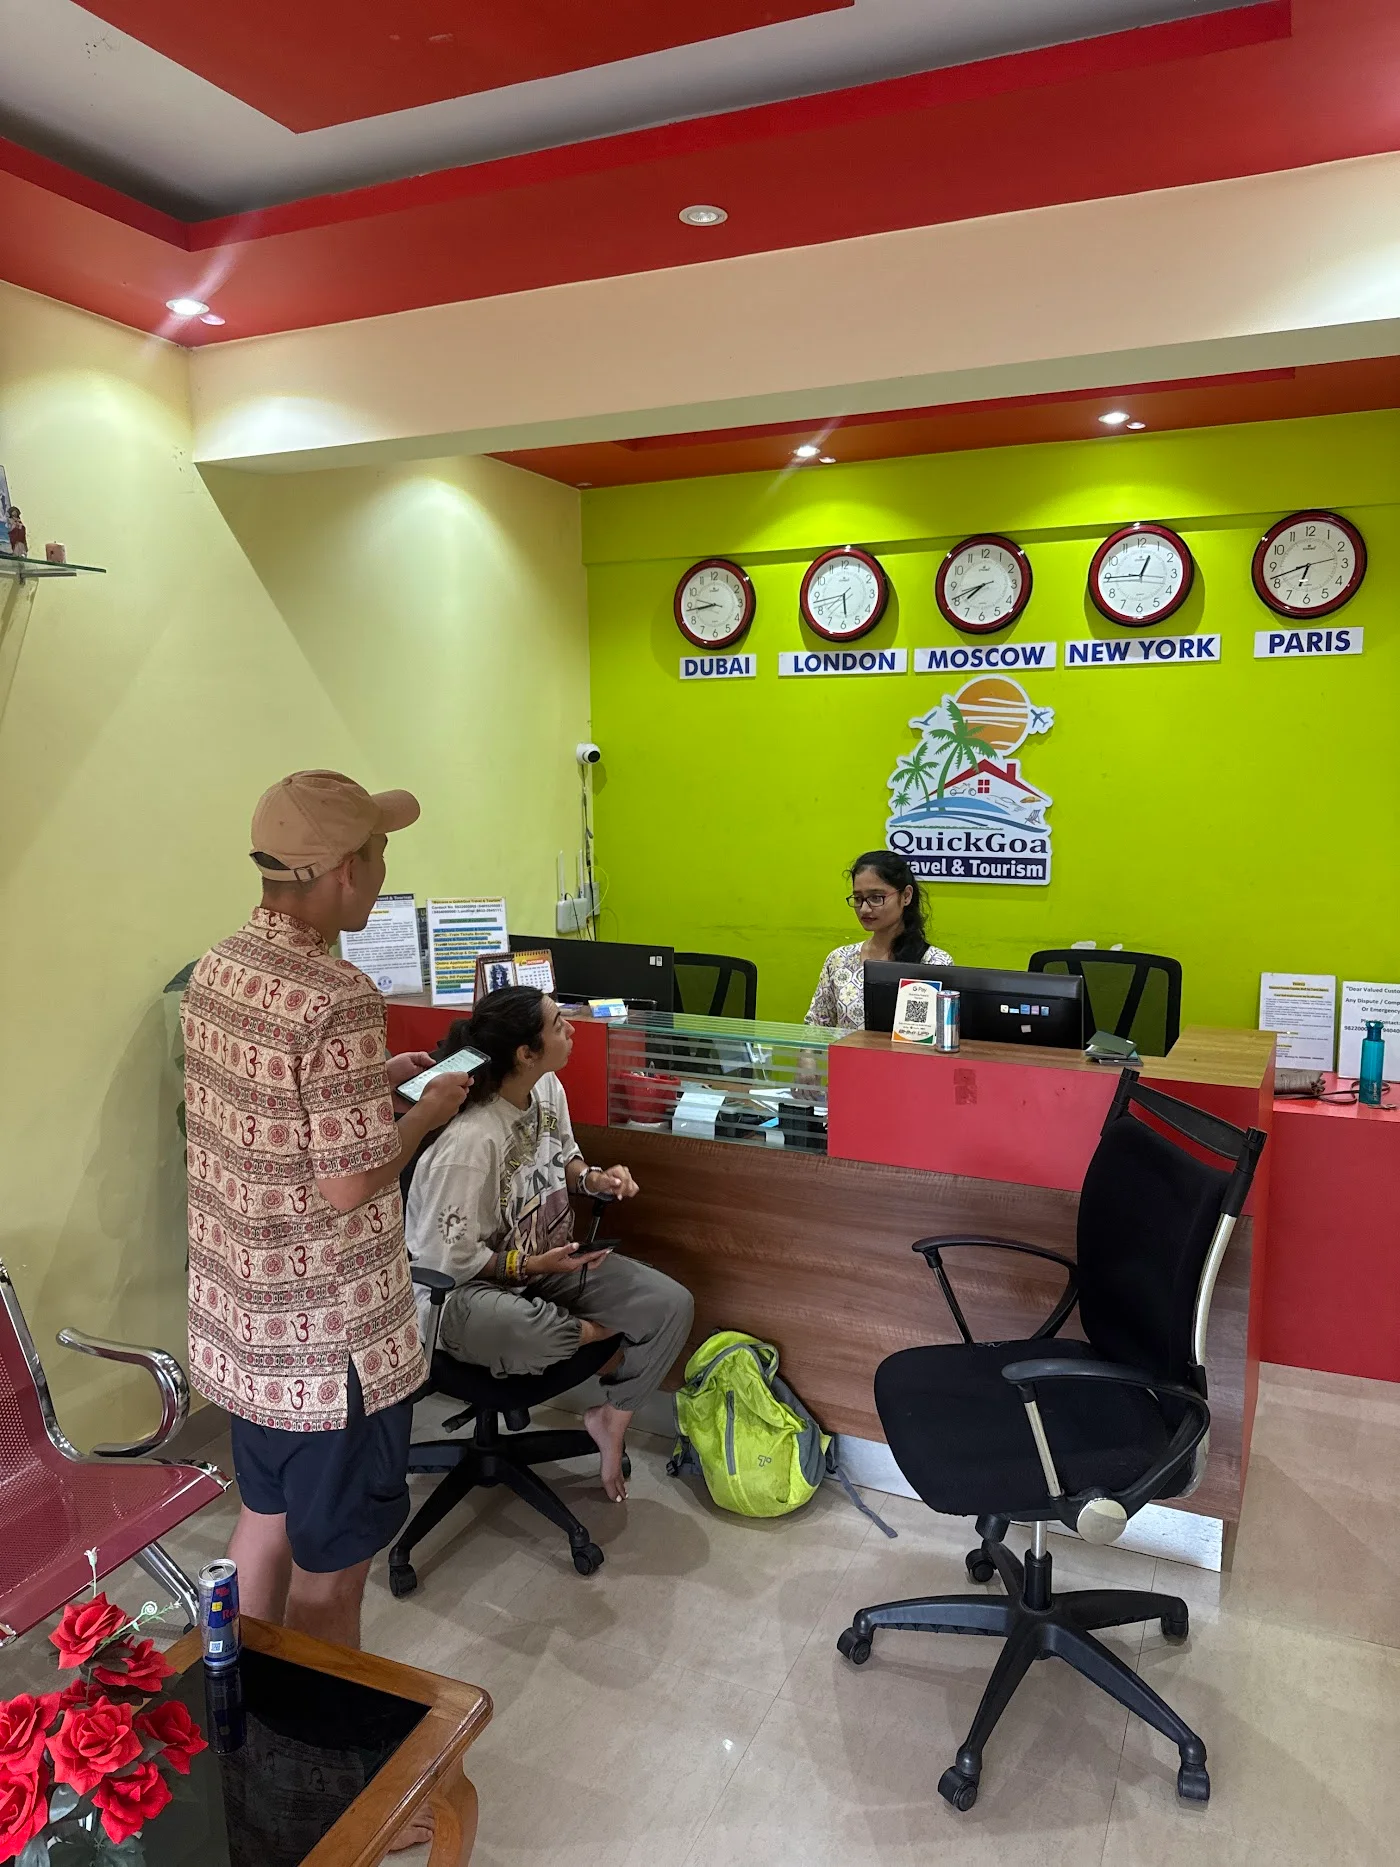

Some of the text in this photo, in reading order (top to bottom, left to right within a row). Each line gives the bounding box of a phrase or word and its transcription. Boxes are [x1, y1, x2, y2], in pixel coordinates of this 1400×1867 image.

[1306, 526, 1316, 537] 12
[1290, 532, 1296, 542] 11
[1137, 538, 1147, 548] 12
[1337, 541, 1345, 552] 2
[982, 549, 990, 558] 12
[1123, 544, 1128, 553] 11
[1274, 544, 1285, 556] 10
[968, 554, 973, 563] 11
[1109, 556, 1119, 567] 10
[1167, 553, 1174, 563] 2
[842, 560, 849, 569] 12
[1269, 561, 1278, 572] 9
[1341, 558, 1349, 569] 3
[829, 565, 834, 574] 11
[955, 566, 963, 576] 10
[1008, 564, 1014, 574] 2
[1171, 569, 1178, 579] 3
[700, 577, 704, 585] 11
[711, 572, 718, 580] 12
[866, 575, 872, 584] 2
[1105, 572, 1112, 583] 9
[1335, 575, 1343, 586] 4
[817, 577, 825, 586] 10
[951, 581, 957, 591] 9
[1011, 579, 1017, 589] 3
[1274, 578, 1281, 589] 8
[689, 588, 697, 597] 10
[734, 585, 740, 594] 2
[869, 589, 875, 598] 3
[1109, 588, 1115, 599] 8
[1166, 585, 1172, 595] 4
[1321, 588, 1329, 599] 5
[814, 592, 820, 600] 9
[1006, 595, 1012, 604] 4
[1286, 590, 1292, 601] 7
[1303, 594, 1311, 605] 6
[687, 602, 693, 610] 9
[738, 599, 743, 607] 3
[954, 597, 960, 606] 8
[1121, 600, 1126, 610] 7
[1153, 597, 1160, 608] 5
[818, 606, 823, 615] 8
[865, 604, 871, 613] 4
[964, 608, 970, 617] 7
[994, 607, 1001, 616] 5
[1136, 603, 1143, 613] 6
[691, 616, 697, 625] 8
[828, 617, 832, 626] 7
[855, 616, 860, 625] 5
[979, 612, 985, 621] 6
[701, 626, 705, 634] 7
[726, 624, 731, 633] 5
[841, 621, 847, 629] 6
[713, 629, 718, 638] 6
[1269, 630, 1351, 654] PARIS
[1069, 637, 1216, 664] NEW YORK
[927, 645, 1045, 669] MOSCOW
[684, 657, 750, 677] DUBAI
[793, 652, 896, 673] LONDON
[889, 829, 1048, 854] QuickGoa
[907, 858, 1044, 877] avel & Tourism
